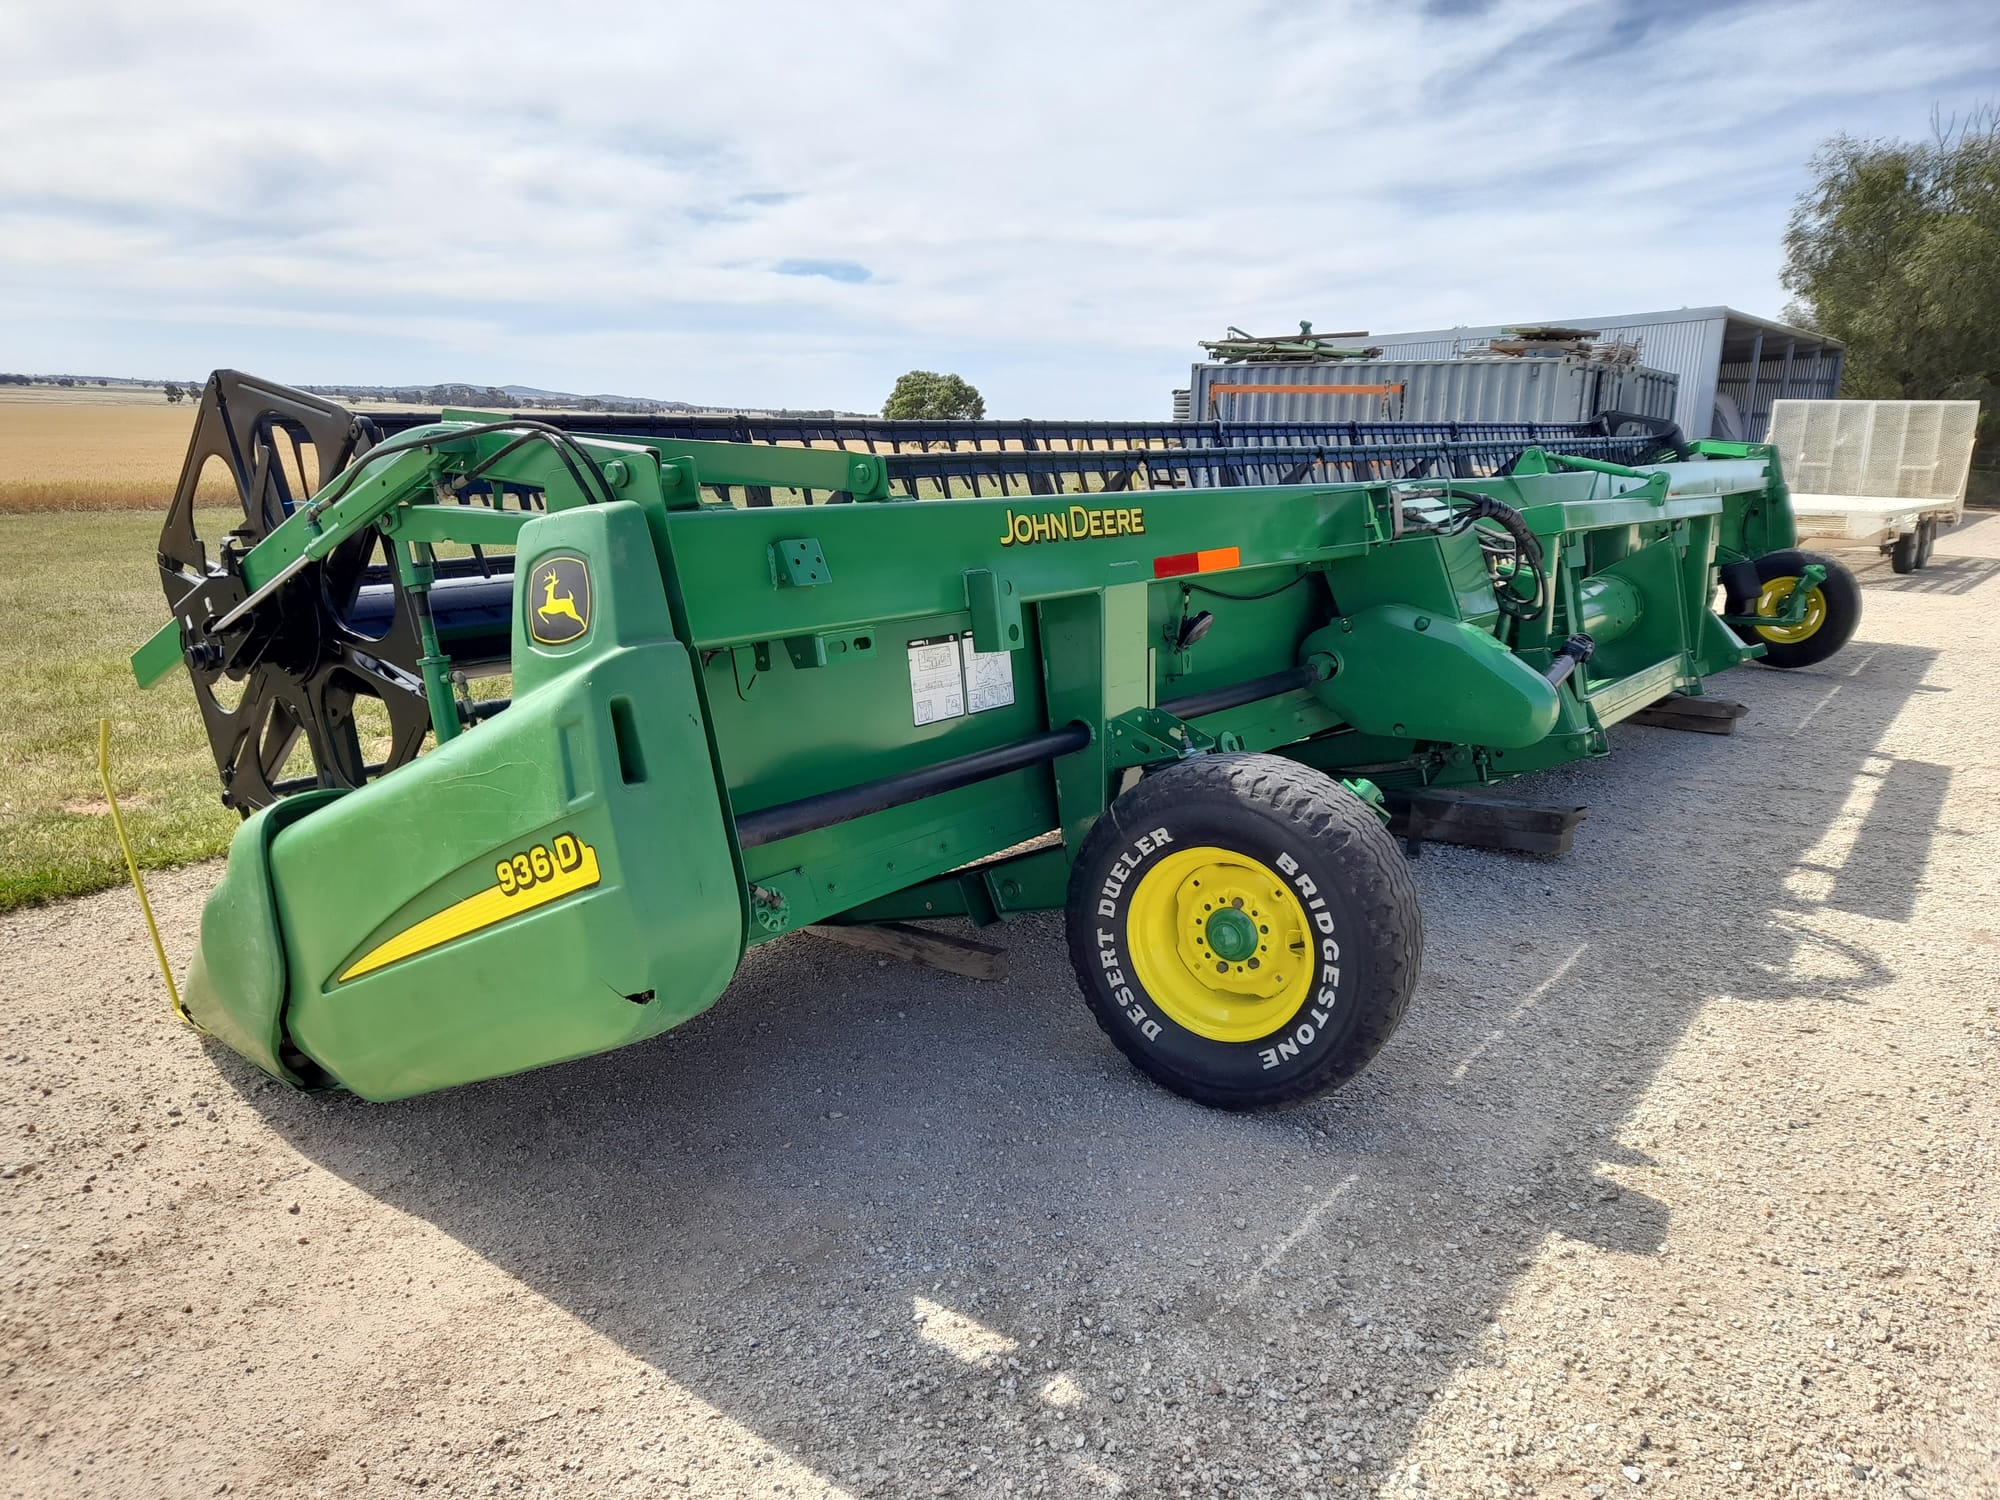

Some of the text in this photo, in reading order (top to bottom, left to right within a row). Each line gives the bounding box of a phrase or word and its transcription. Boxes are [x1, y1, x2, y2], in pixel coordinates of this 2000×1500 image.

[1000, 505, 1145, 545] JOHN DEERE
[1097, 827, 1173, 1042] DESERT DUELER
[1258, 852, 1340, 1070] BRIDGESTONE
